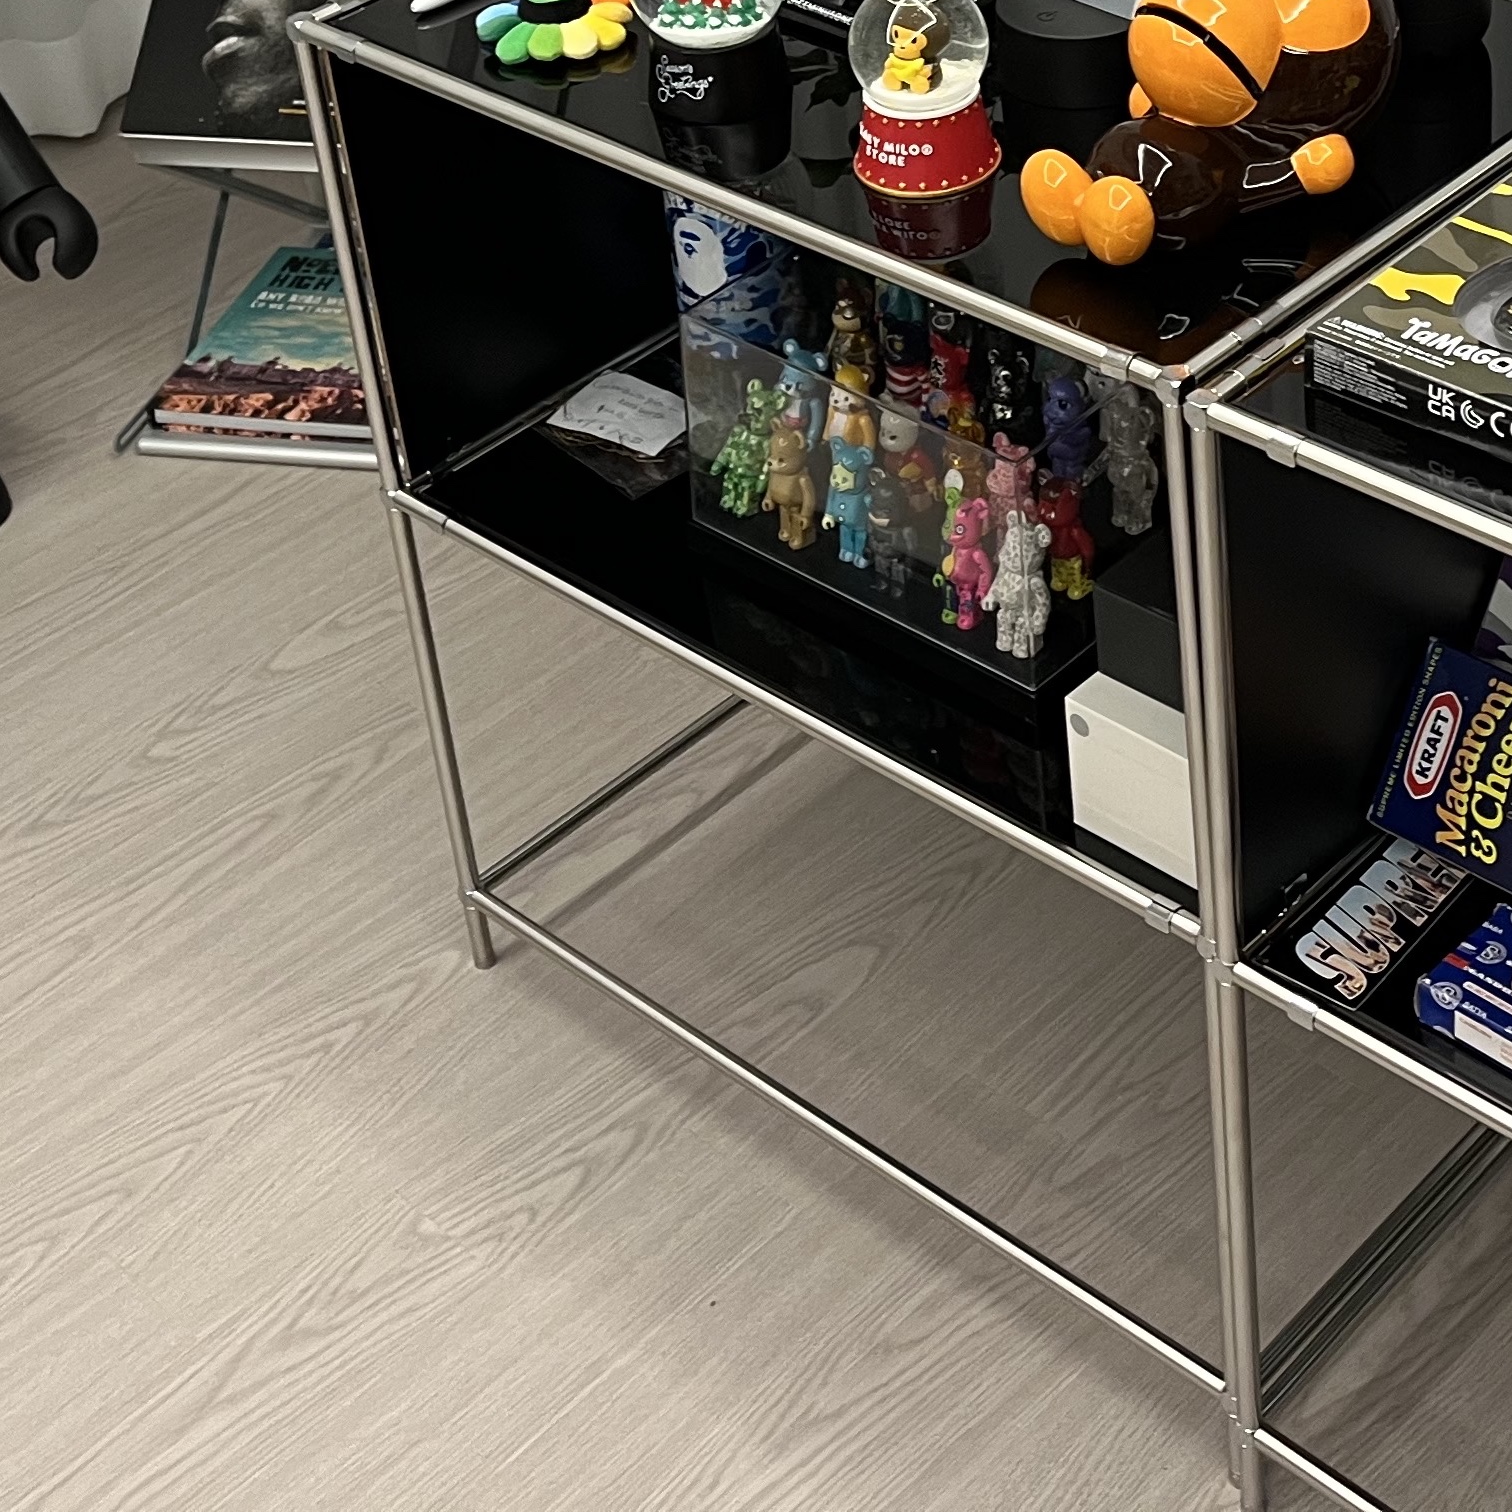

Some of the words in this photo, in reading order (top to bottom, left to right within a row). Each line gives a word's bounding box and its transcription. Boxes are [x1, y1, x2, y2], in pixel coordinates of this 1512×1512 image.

[865, 144, 906, 167] STORE
[882, 141, 921, 157] MILO
[1427, 383, 1456, 406] UK
[1427, 399, 1456, 422] CA
[1414, 709, 1450, 780] KRAFT
[1469, 828, 1498, 865] &
[1295, 836, 1468, 1000] SUPRE
